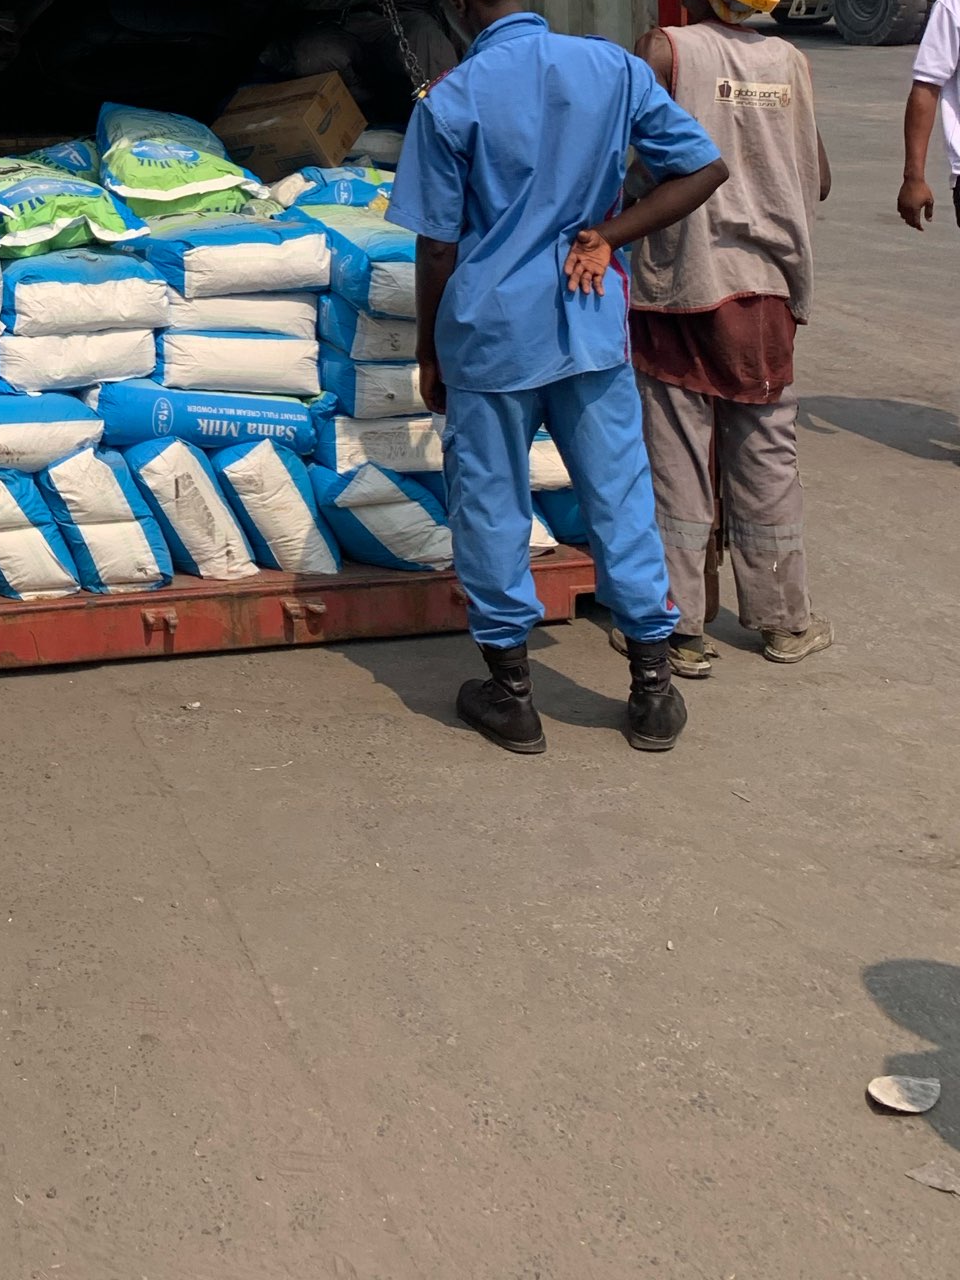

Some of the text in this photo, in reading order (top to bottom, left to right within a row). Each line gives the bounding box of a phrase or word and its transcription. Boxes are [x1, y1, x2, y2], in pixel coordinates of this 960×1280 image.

[186, 405, 308, 421] INSTANT FULL CREAM MILK POWDER
[197, 418, 297, 442] Sama Milk
